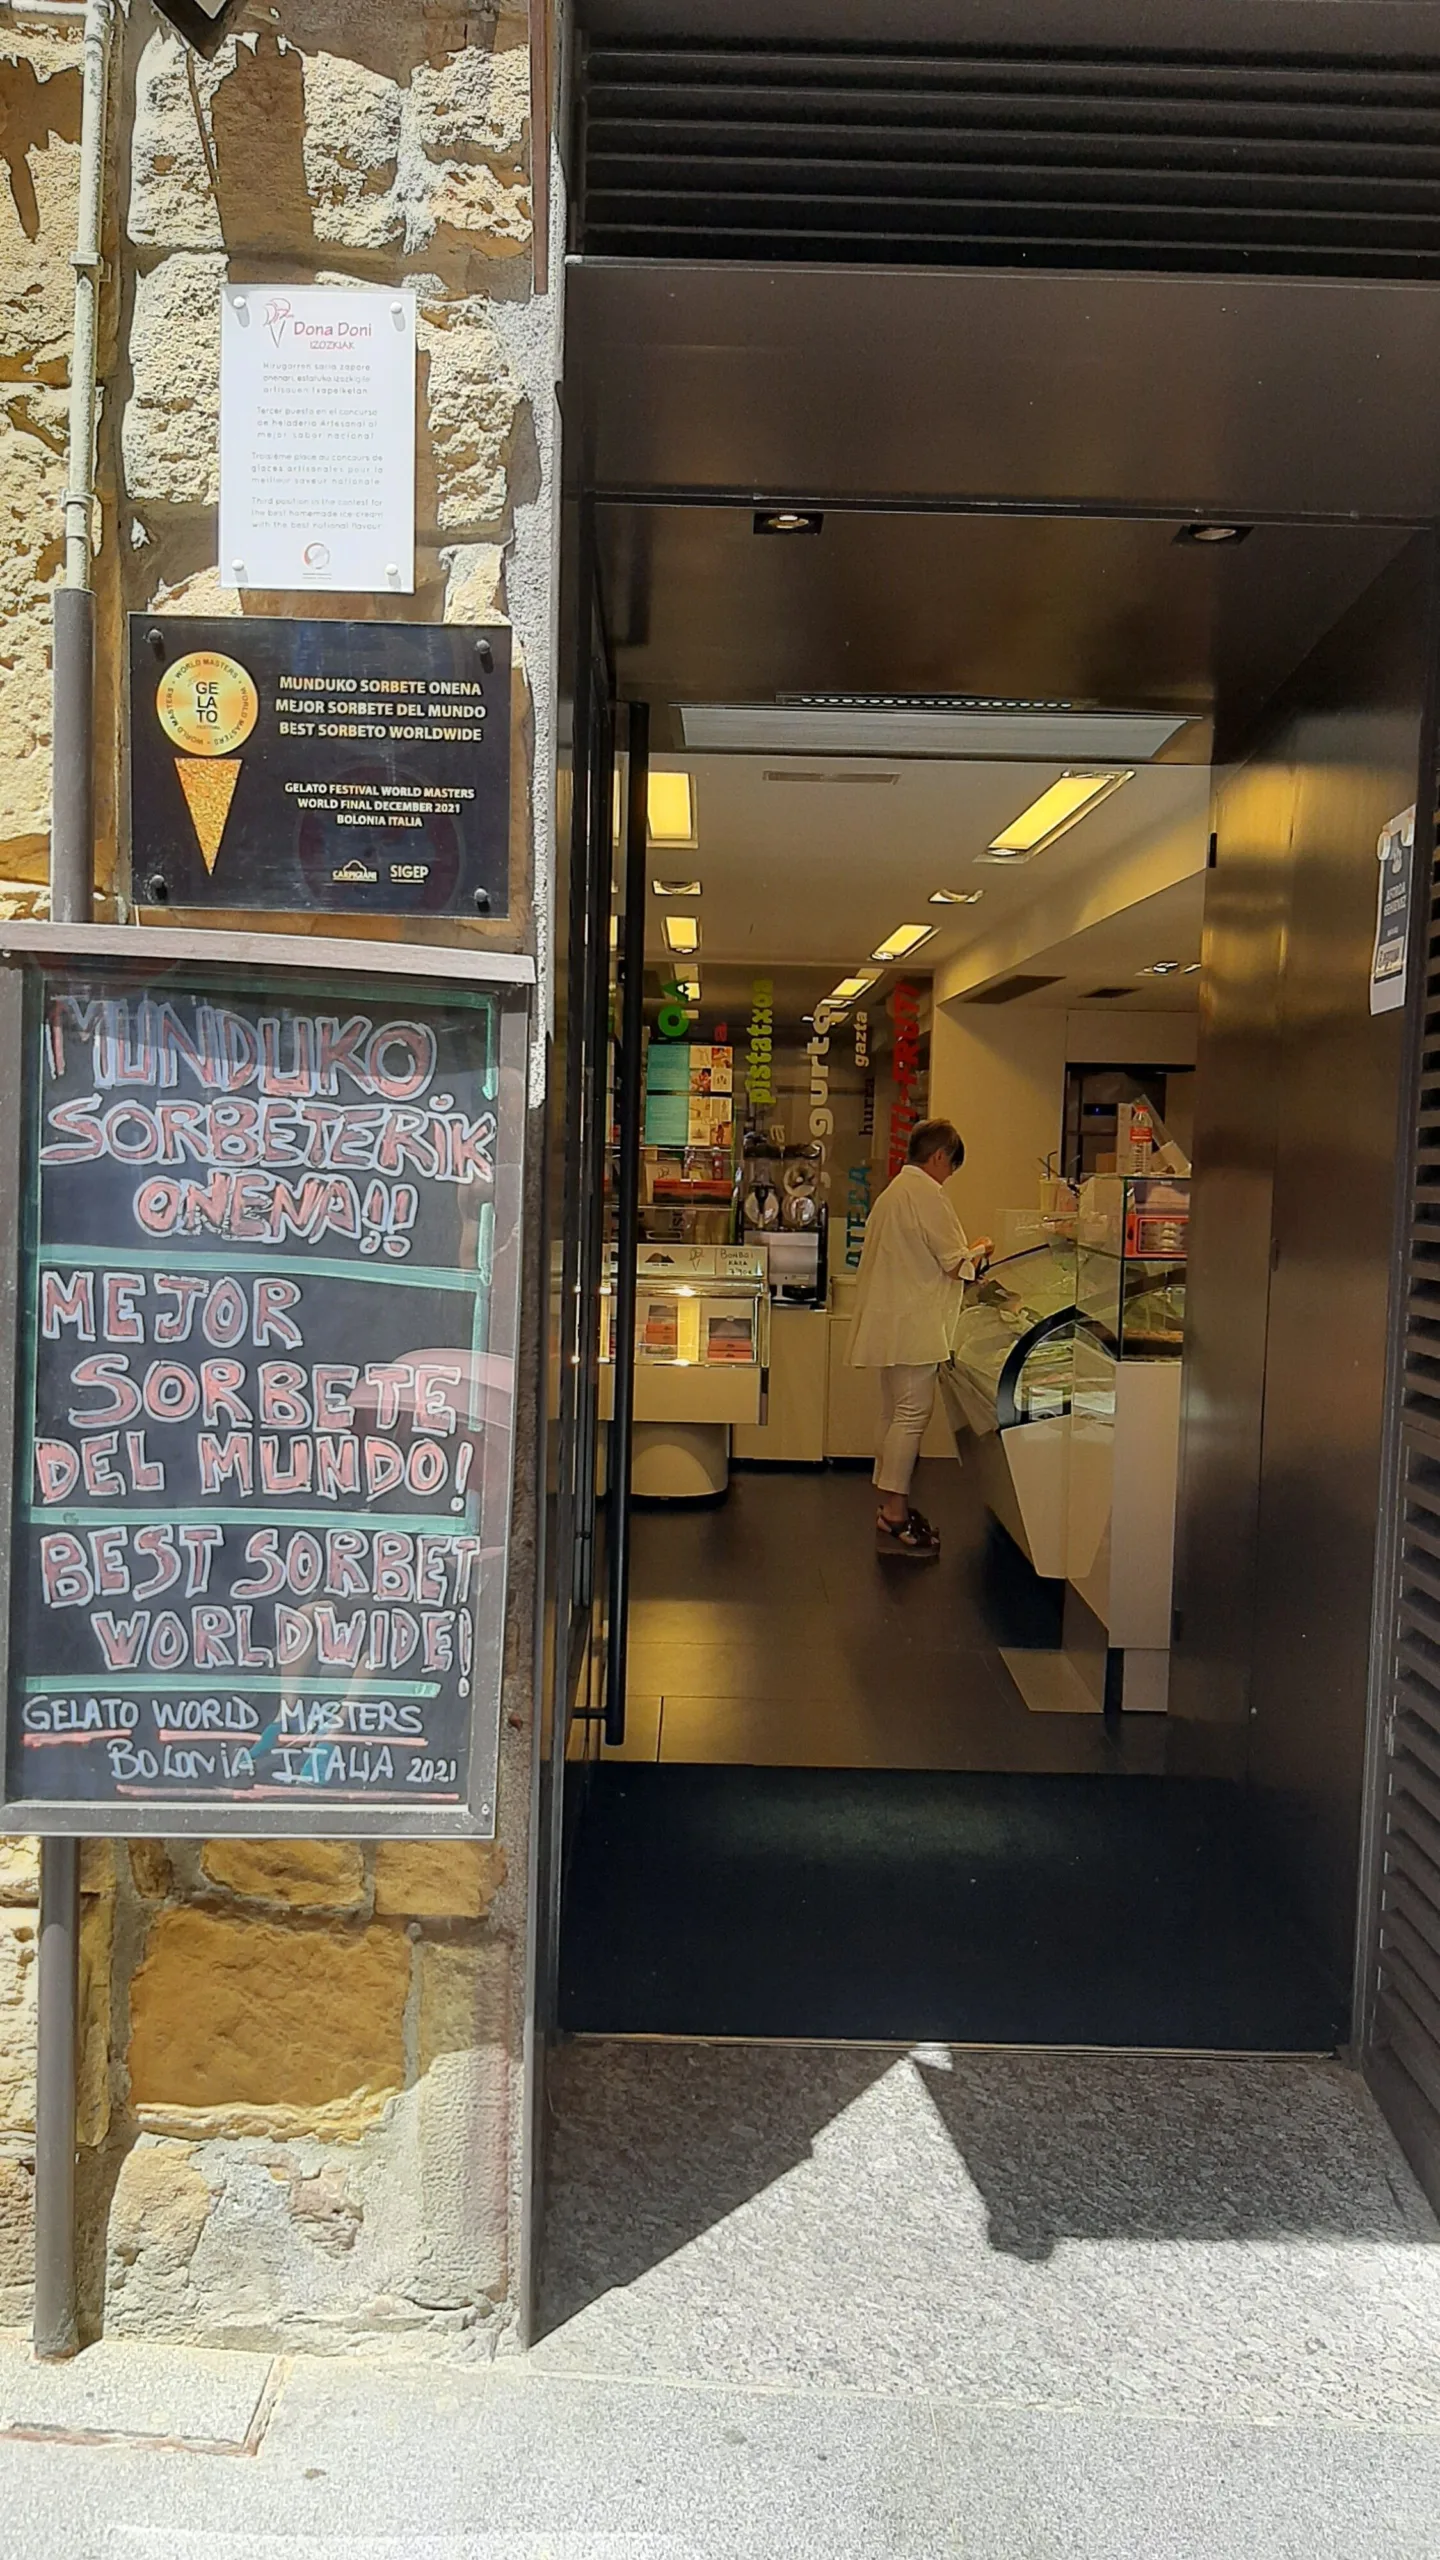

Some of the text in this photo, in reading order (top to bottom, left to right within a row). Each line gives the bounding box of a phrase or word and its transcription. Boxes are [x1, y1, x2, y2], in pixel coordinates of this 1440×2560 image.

[294, 321, 372, 336] Dona Doni
[309, 340, 355, 350] IZOZKIAK
[263, 362, 311, 371] Hirugarren
[257, 406, 282, 415] Tercer
[285, 408, 314, 417] puesto
[339, 408, 378, 416] concurso
[257, 431, 375, 440] mejor sabor nacional
[294, 453, 317, 462] place
[372, 453, 383, 462] de
[251, 464, 383, 474] glaces artisanales pour la
[331, 477, 380, 485] nationale
[252, 496, 273, 505] Third
[275, 498, 308, 506] position
[371, 498, 383, 506] for
[267, 509, 286, 517] best
[289, 510, 338, 518] homemade
[340, 510, 352, 518] ice
[355, 511, 384, 519] cream
[290, 521, 310, 529] best
[312, 522, 349, 530] national
[175, 658, 239, 679] WORLD MASTERS
[196, 681, 219, 695] GE
[279, 676, 482, 696] MUNDUKO SORBETE ONENA
[197, 695, 218, 709] LA
[275, 699, 486, 719] MEJOR SORBETE DEL MUNDO
[196, 709, 218, 723] TO
[279, 721, 482, 741] BEST SORBETO WORLDWIDE
[285, 783, 475, 799] GELATO FESTIVAL WORLD MASTERS
[297, 798, 461, 813] WORLD FINAL DECEMBER 2021
[337, 814, 423, 827] BOLONIA ITALIA
[390, 865, 429, 879] SIGEP
[746, 978, 777, 1106] pistatxoa
[854, 1011, 870, 1068] gazta
[45, 995, 437, 1101] MUNDUKO
[133, 1168, 419, 1257] ONENA!!
[41, 1271, 304, 1349] MEJOR
[67, 1352, 462, 1434] SORBETE
[33, 1429, 474, 1512] DEL MUNDO!
[41, 1524, 481, 1608] BEST SORBET
[90, 1601, 474, 1698] WORLDWIDE!
[22, 1695, 424, 1734] GELATO WORLD MASTERS
[405, 1757, 459, 1783] 2021
